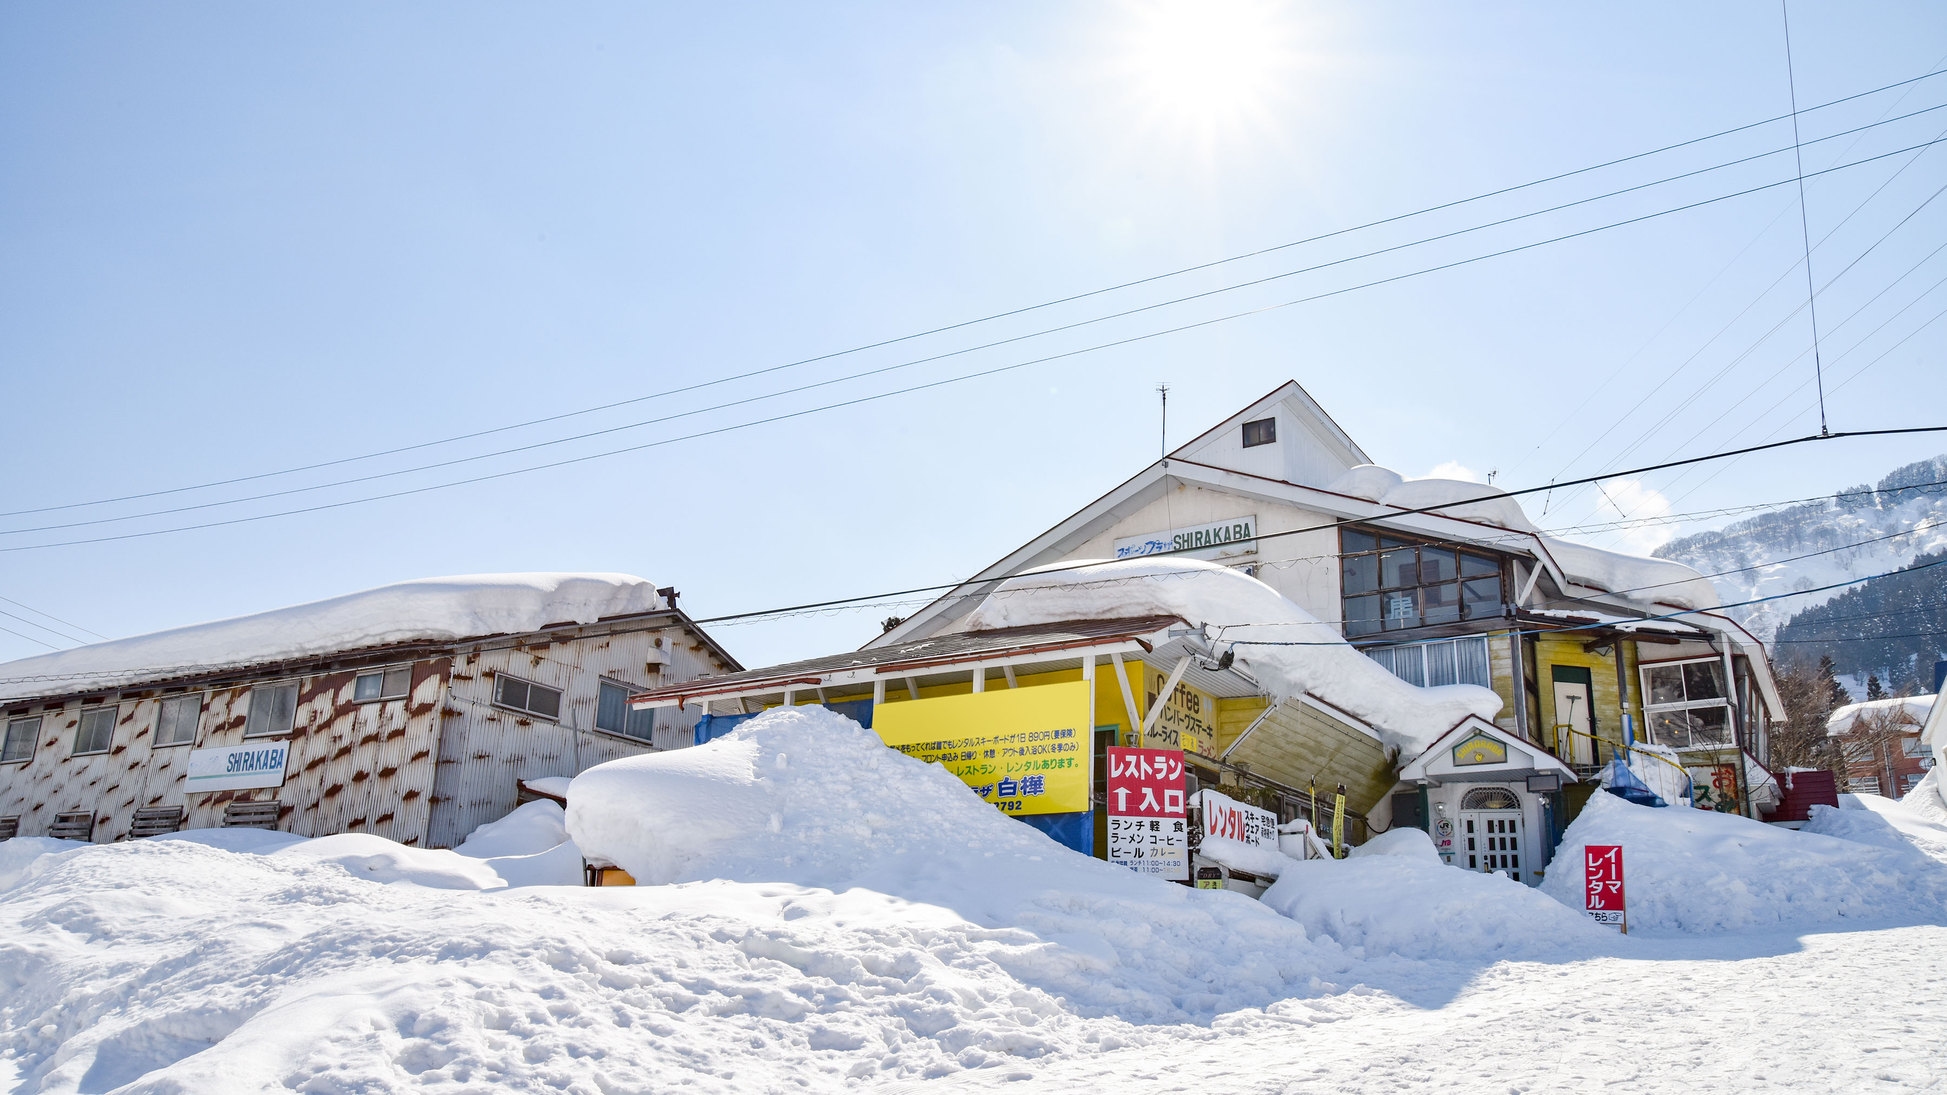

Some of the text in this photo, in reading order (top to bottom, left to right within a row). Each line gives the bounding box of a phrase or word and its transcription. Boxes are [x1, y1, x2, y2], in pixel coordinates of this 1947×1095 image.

[1173, 522, 1252, 551] SHIRAKABA
[1157, 674, 1200, 715] Cffee
[226, 748, 285, 772] SHIRAKABA
[1110, 754, 1182, 780] レストラン
[997, 775, 1044, 797] 白樺
[1139, 787, 1184, 814] 入口
[1111, 819, 1145, 831] ランチ
[1209, 799, 1246, 843] レンタル
[1244, 810, 1260, 823] スキー
[1111, 832, 1183, 846] ラーメン コーヒー
[1245, 822, 1260, 835] ウェア
[1245, 834, 1260, 847] ボード
[1440, 839, 1452, 847] JTB
[1111, 847, 1176, 858] ビール カレー
[1588, 853, 1605, 909] レンタル
[1604, 847, 1622, 894] イーマ
